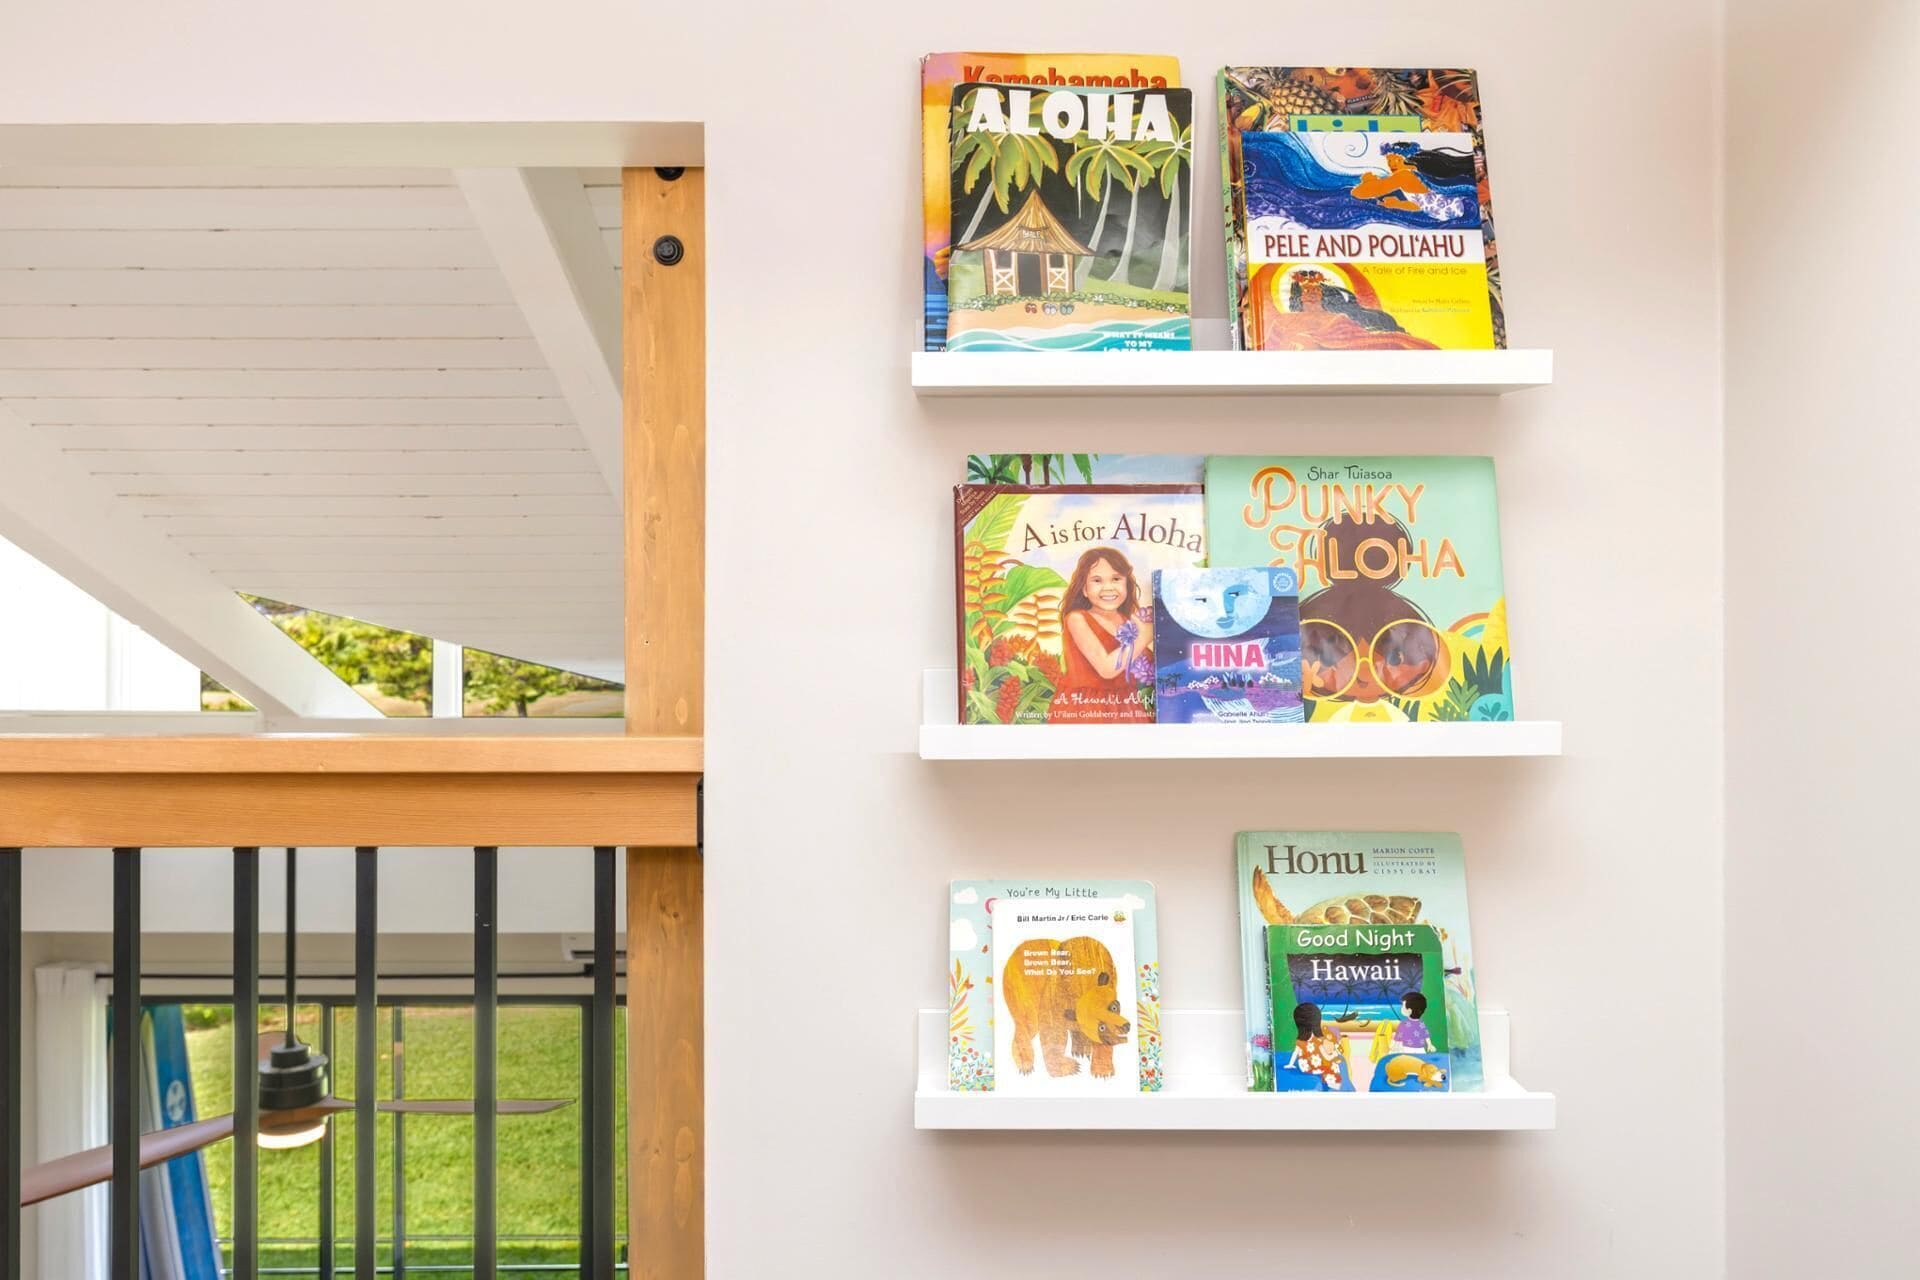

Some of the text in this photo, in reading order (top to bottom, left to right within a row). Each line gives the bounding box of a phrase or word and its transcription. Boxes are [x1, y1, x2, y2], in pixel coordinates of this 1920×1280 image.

[967, 87, 1173, 141] ALOHA
[1264, 234, 1310, 258] PELE
[1316, 234, 1362, 258] AND
[1373, 266, 1392, 274] Tale
[1394, 266, 1406, 275] of
[1407, 266, 1425, 274] Fire
[1426, 266, 1449, 274] and
[1451, 266, 1467, 274] Ice
[1307, 465, 1393, 481] Shar Tuiasoa
[1243, 466, 1425, 529] PUNKY
[1022, 513, 1202, 553] A is for Aloha
[1268, 525, 1465, 591] ALOHA
[1192, 643, 1265, 669] HINA
[1054, 693, 1068, 705] A
[1015, 711, 1041, 719] Written
[1043, 711, 1052, 721] by
[1120, 710, 1133, 718] and
[1263, 845, 1368, 875] Honu
[1006, 887, 1098, 899] You're My Little
[1297, 929, 1415, 951] Good Night
[1024, 949, 1071, 957] Brown Bear,
[1050, 959, 1072, 967] Bear,
[1076, 967, 1096, 975] See?
[1310, 959, 1402, 981] Hawaii
